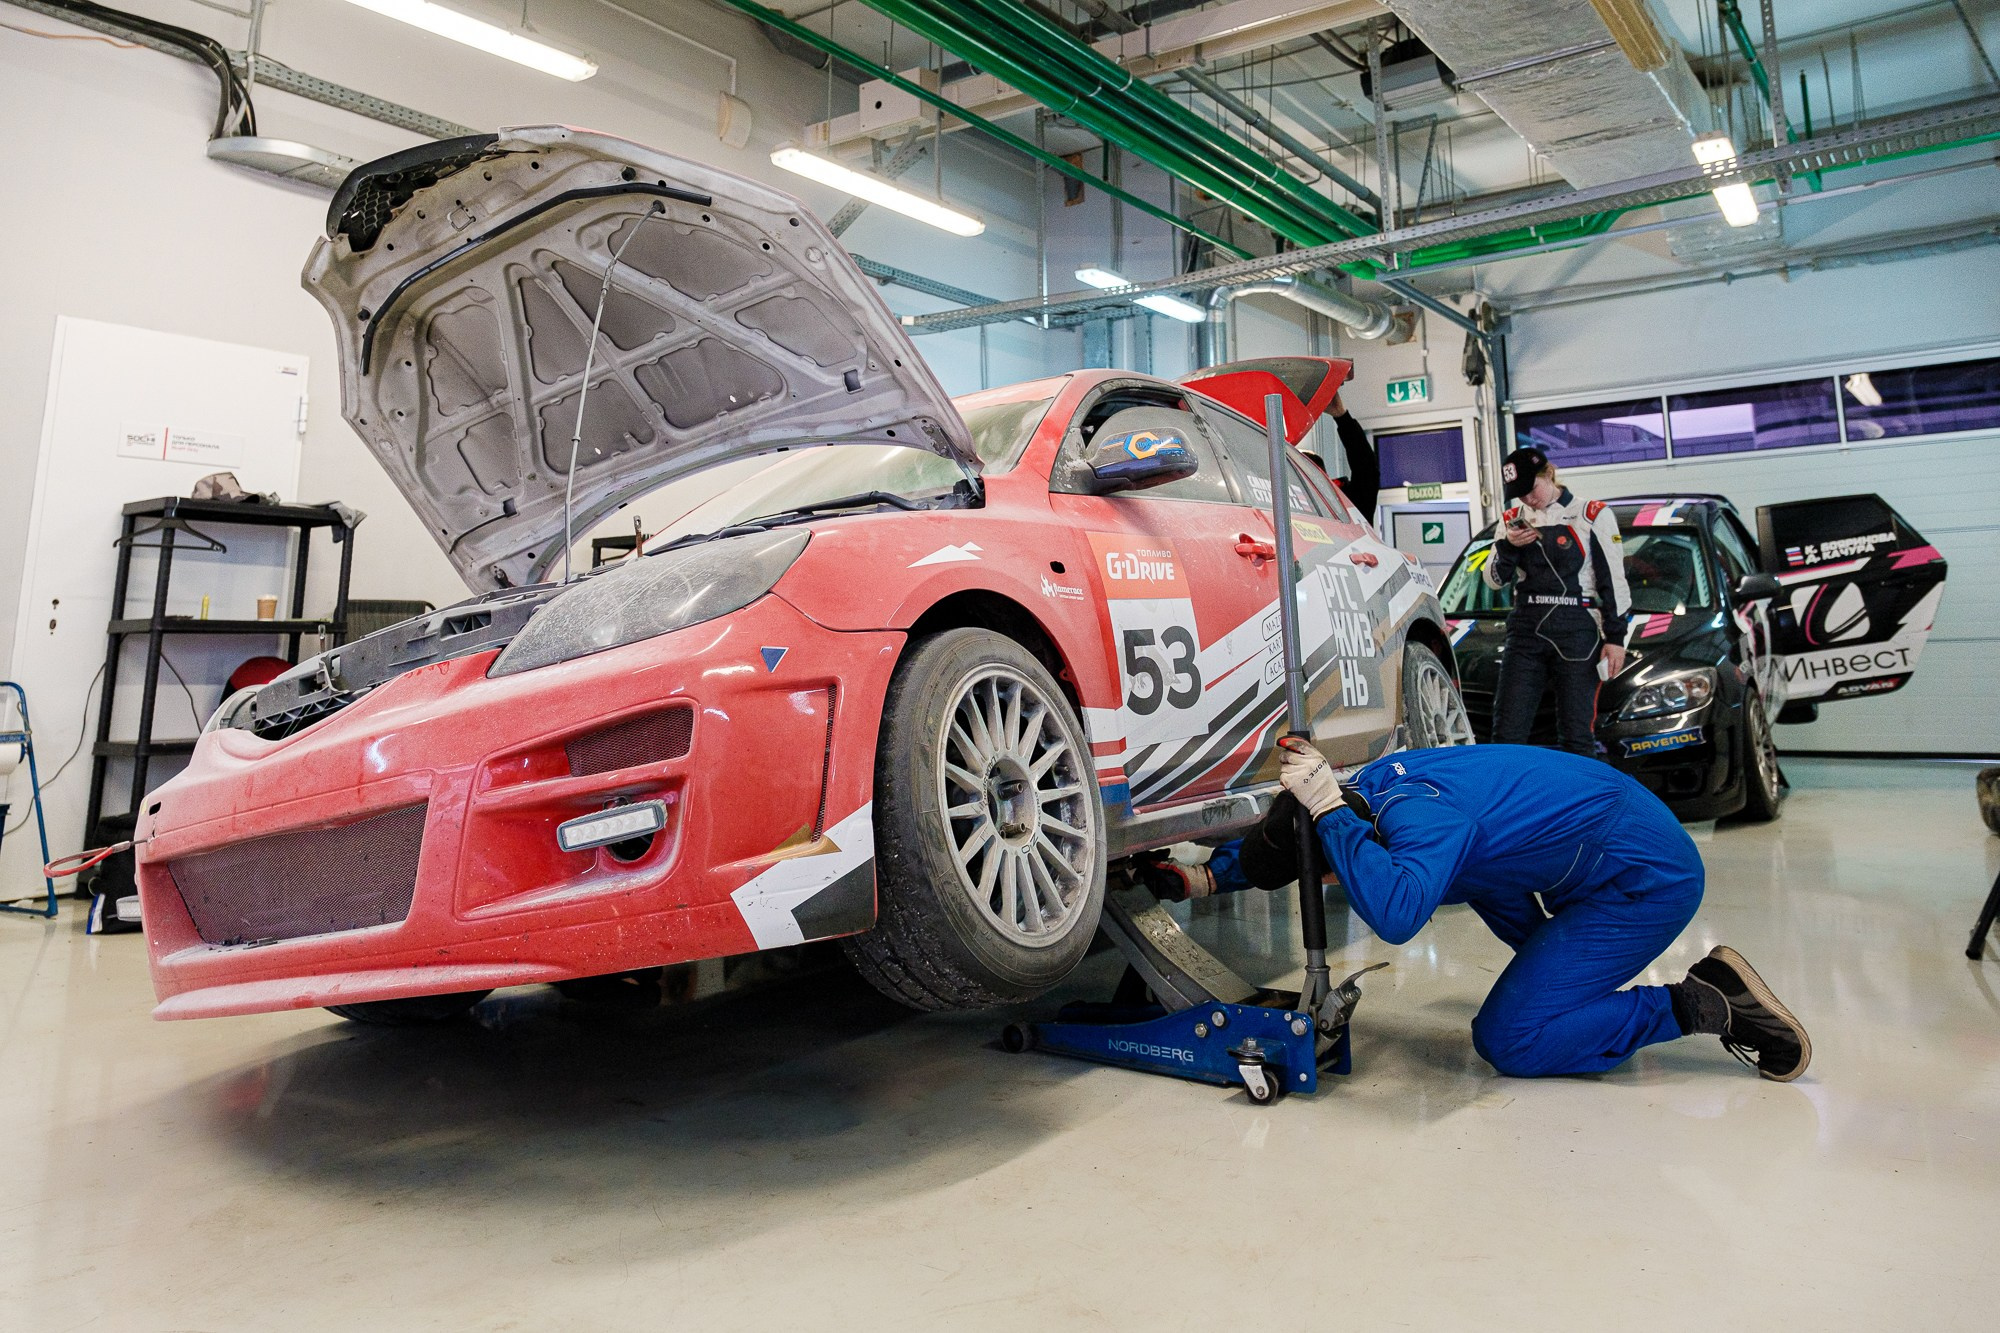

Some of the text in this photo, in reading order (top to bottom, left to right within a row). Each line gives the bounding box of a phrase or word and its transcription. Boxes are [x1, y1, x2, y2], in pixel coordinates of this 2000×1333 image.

[1503, 462, 1518, 483] 53
[1409, 486, 1441, 500] ВЫХОД
[1137, 549, 1172, 558] ТОПЛИВО
[1822, 543, 1876, 560] КАЧУРА
[1315, 564, 1359, 611] РГС
[1528, 594, 1578, 606] A. SUKHANOVA
[1331, 610, 1377, 658] ЖИЗ
[1123, 625, 1202, 716] 53
[1338, 659, 1370, 707] НЬ
[1837, 681, 1896, 694] ADVAN
[1631, 732, 1697, 752] RAVENOL
[1108, 1038, 1194, 1063] NORDBERG
